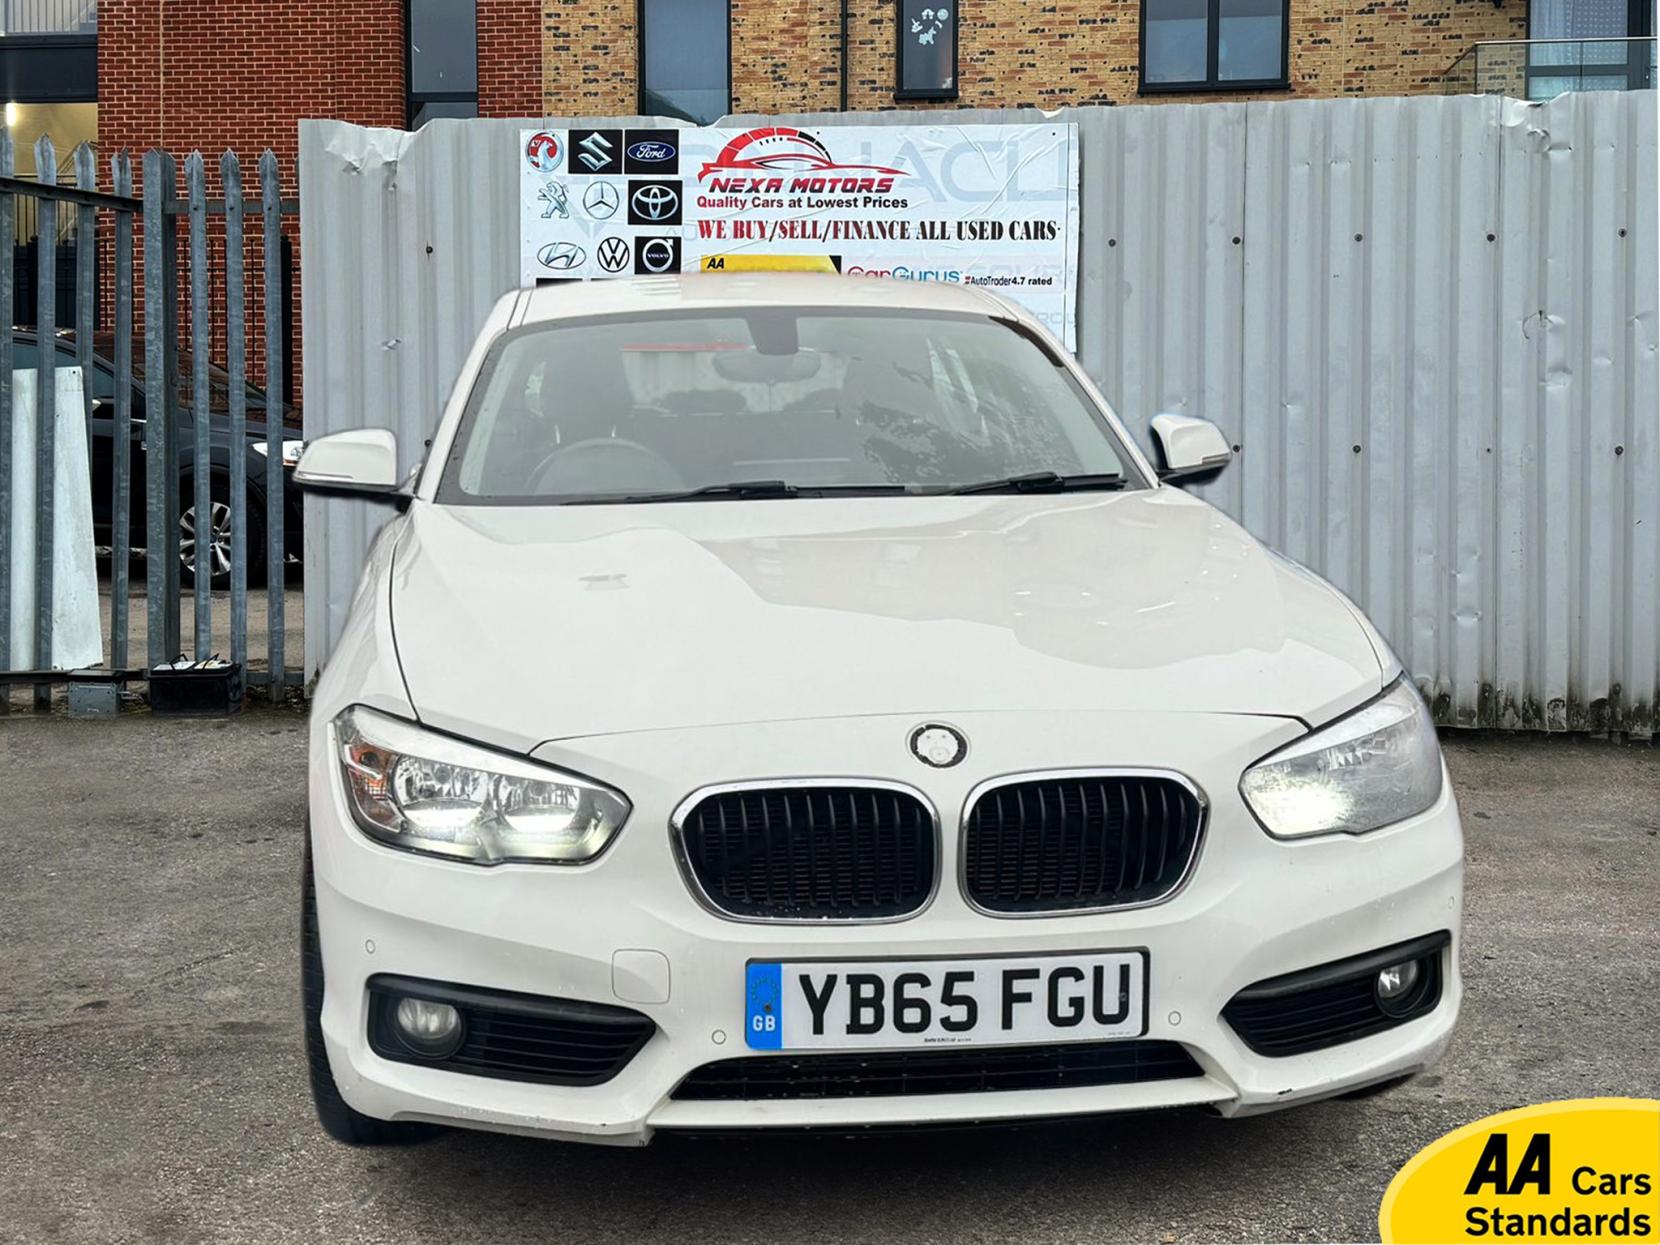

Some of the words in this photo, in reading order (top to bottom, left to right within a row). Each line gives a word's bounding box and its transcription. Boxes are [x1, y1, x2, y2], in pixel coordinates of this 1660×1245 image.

[636, 144, 666, 159] Ford
[709, 178, 782, 193] NEXA
[789, 178, 894, 193] MOTORS
[696, 196, 748, 210] Quality
[751, 196, 784, 207] Cars
[788, 196, 802, 207] at
[806, 196, 858, 208] Lowest
[863, 196, 908, 208] Prices
[697, 220, 727, 240] WE
[733, 220, 911, 242] BUY/SELL/FINANCE
[916, 220, 951, 240] ALL
[956, 220, 1004, 240] USED
[1008, 220, 1057, 240] CARS
[707, 258, 724, 268] AA
[1028, 276, 1053, 285] rated
[799, 971, 978, 1035] YB65
[1001, 964, 1130, 1030] FGU
[753, 1016, 776, 1031] GB
